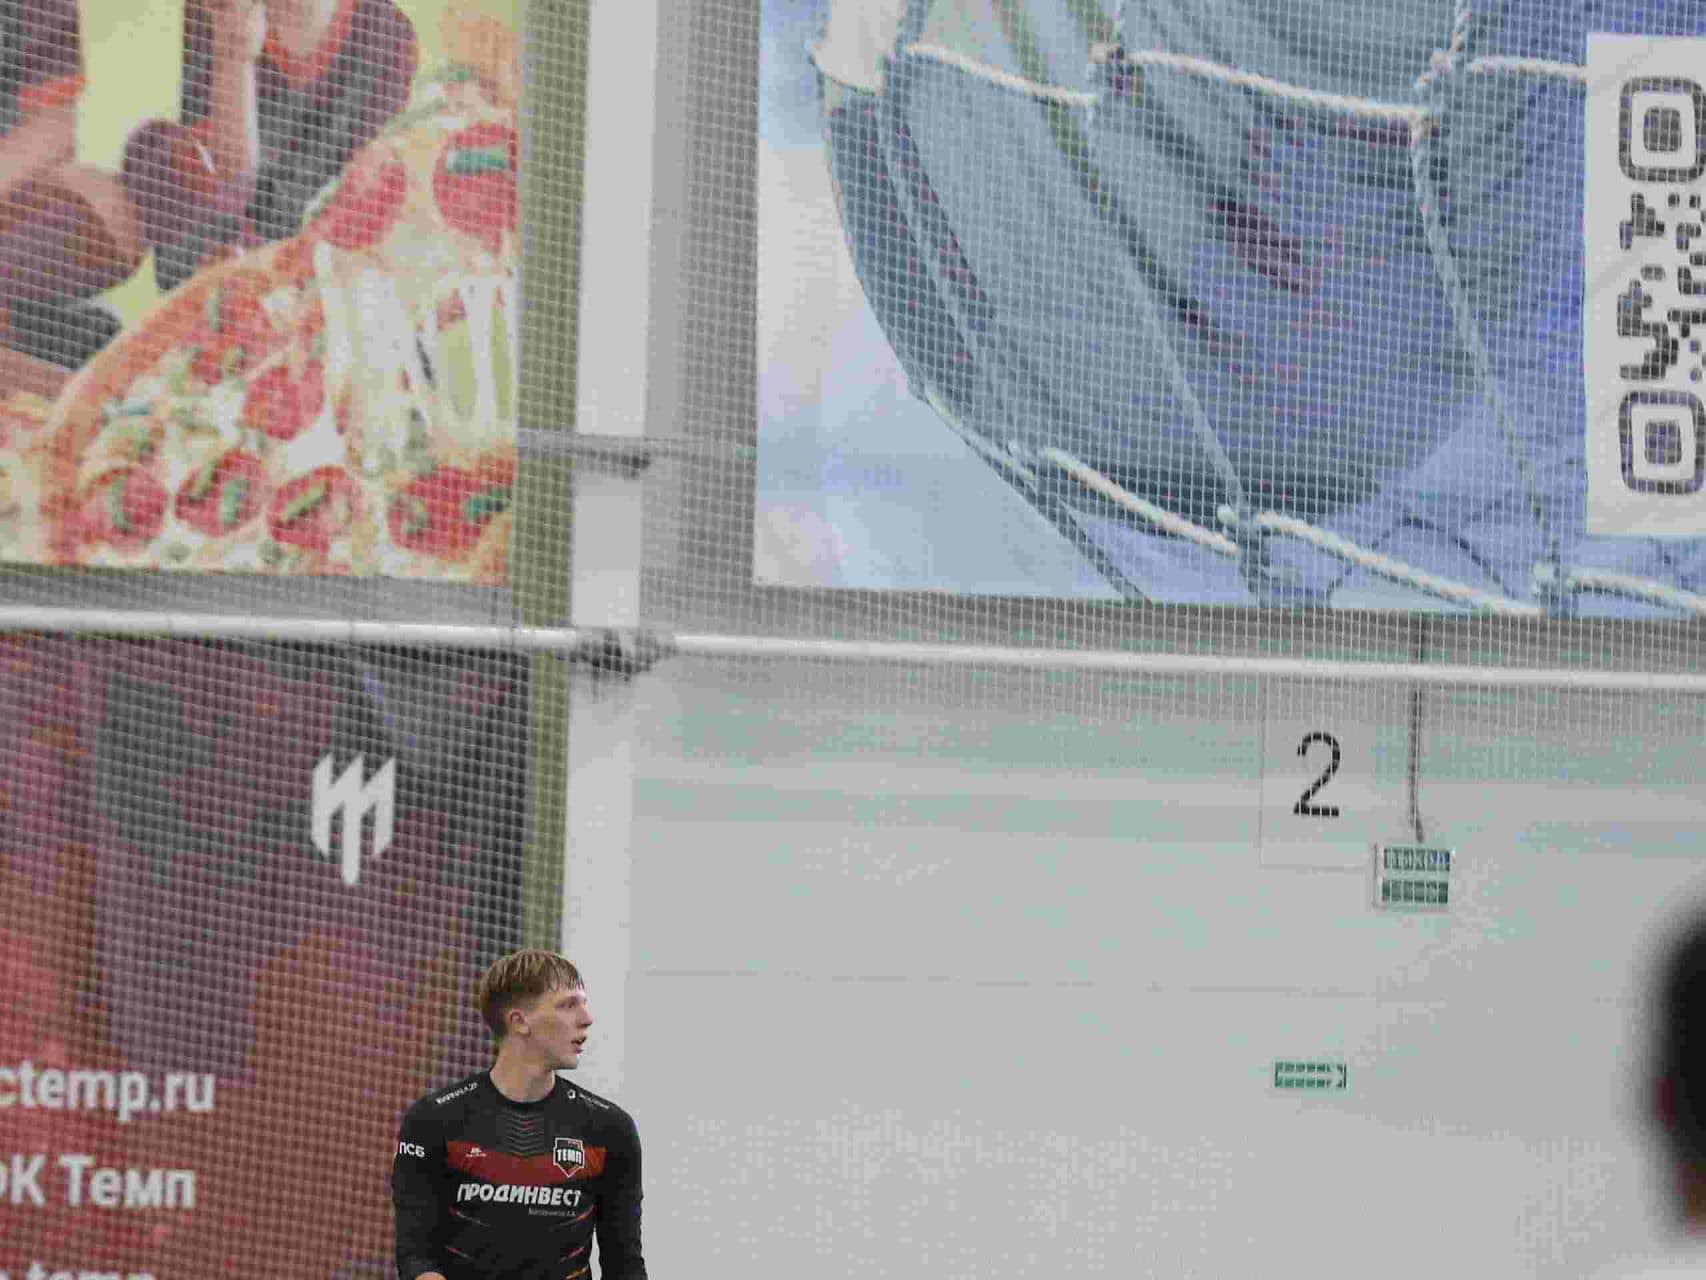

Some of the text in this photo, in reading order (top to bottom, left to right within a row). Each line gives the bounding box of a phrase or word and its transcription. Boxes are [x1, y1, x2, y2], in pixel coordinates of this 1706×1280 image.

[1293, 731, 1340, 816] 2
[0, 1060, 215, 1122] ctemp.ru
[0, 1153, 196, 1208] К Темп
[556, 1148, 582, 1165] ТЕМП
[456, 1182, 582, 1207] ПРОДИНВЕСТ
